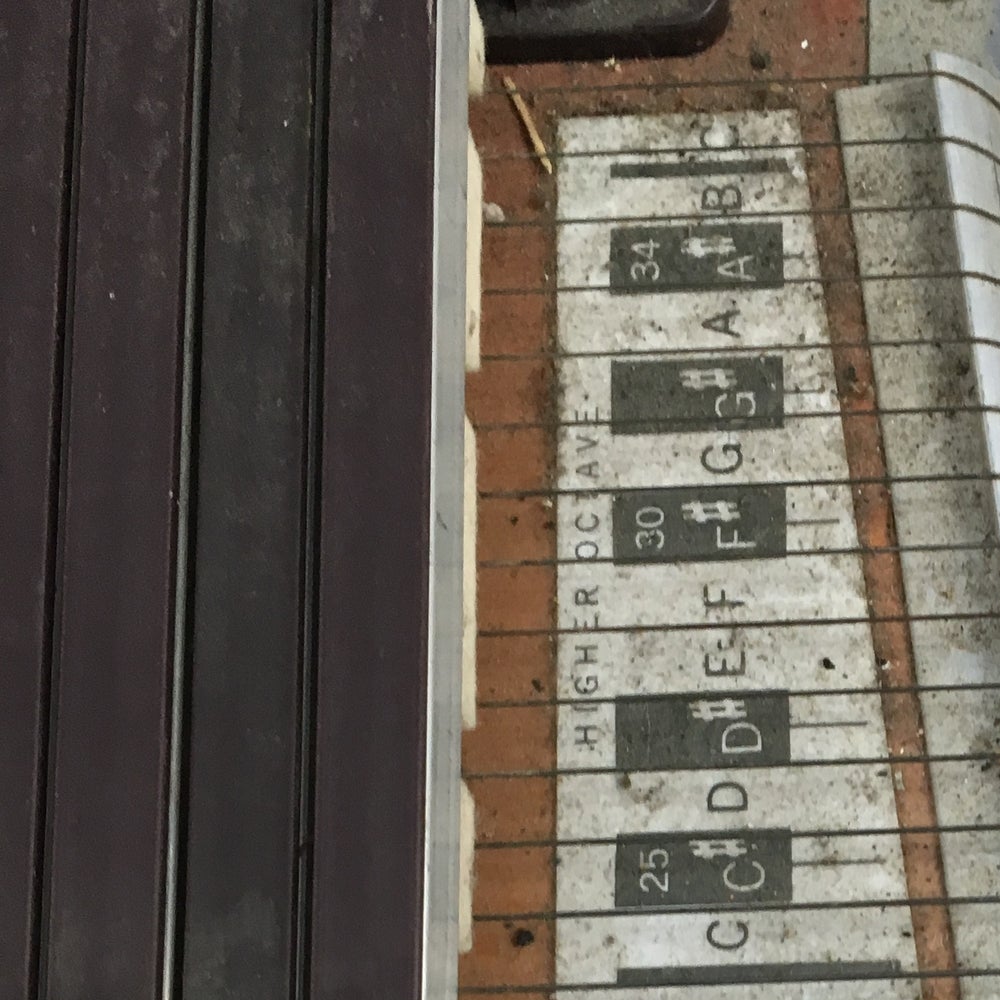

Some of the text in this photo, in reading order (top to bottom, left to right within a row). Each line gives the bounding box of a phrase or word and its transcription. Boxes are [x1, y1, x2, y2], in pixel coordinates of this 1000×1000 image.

[701, 184, 742, 211] B
[631, 239, 660, 281] 34
[702, 310, 740, 337] A
[701, 442, 743, 474] G
[635, 506, 664, 550] 30
[574, 406, 600, 745] HIGHER OCAVE
[703, 583, 745, 607] F
[704, 650, 746, 676] E
[707, 781, 748, 812] D
[640, 848, 669, 893] 25
[707, 920, 748, 951] C
